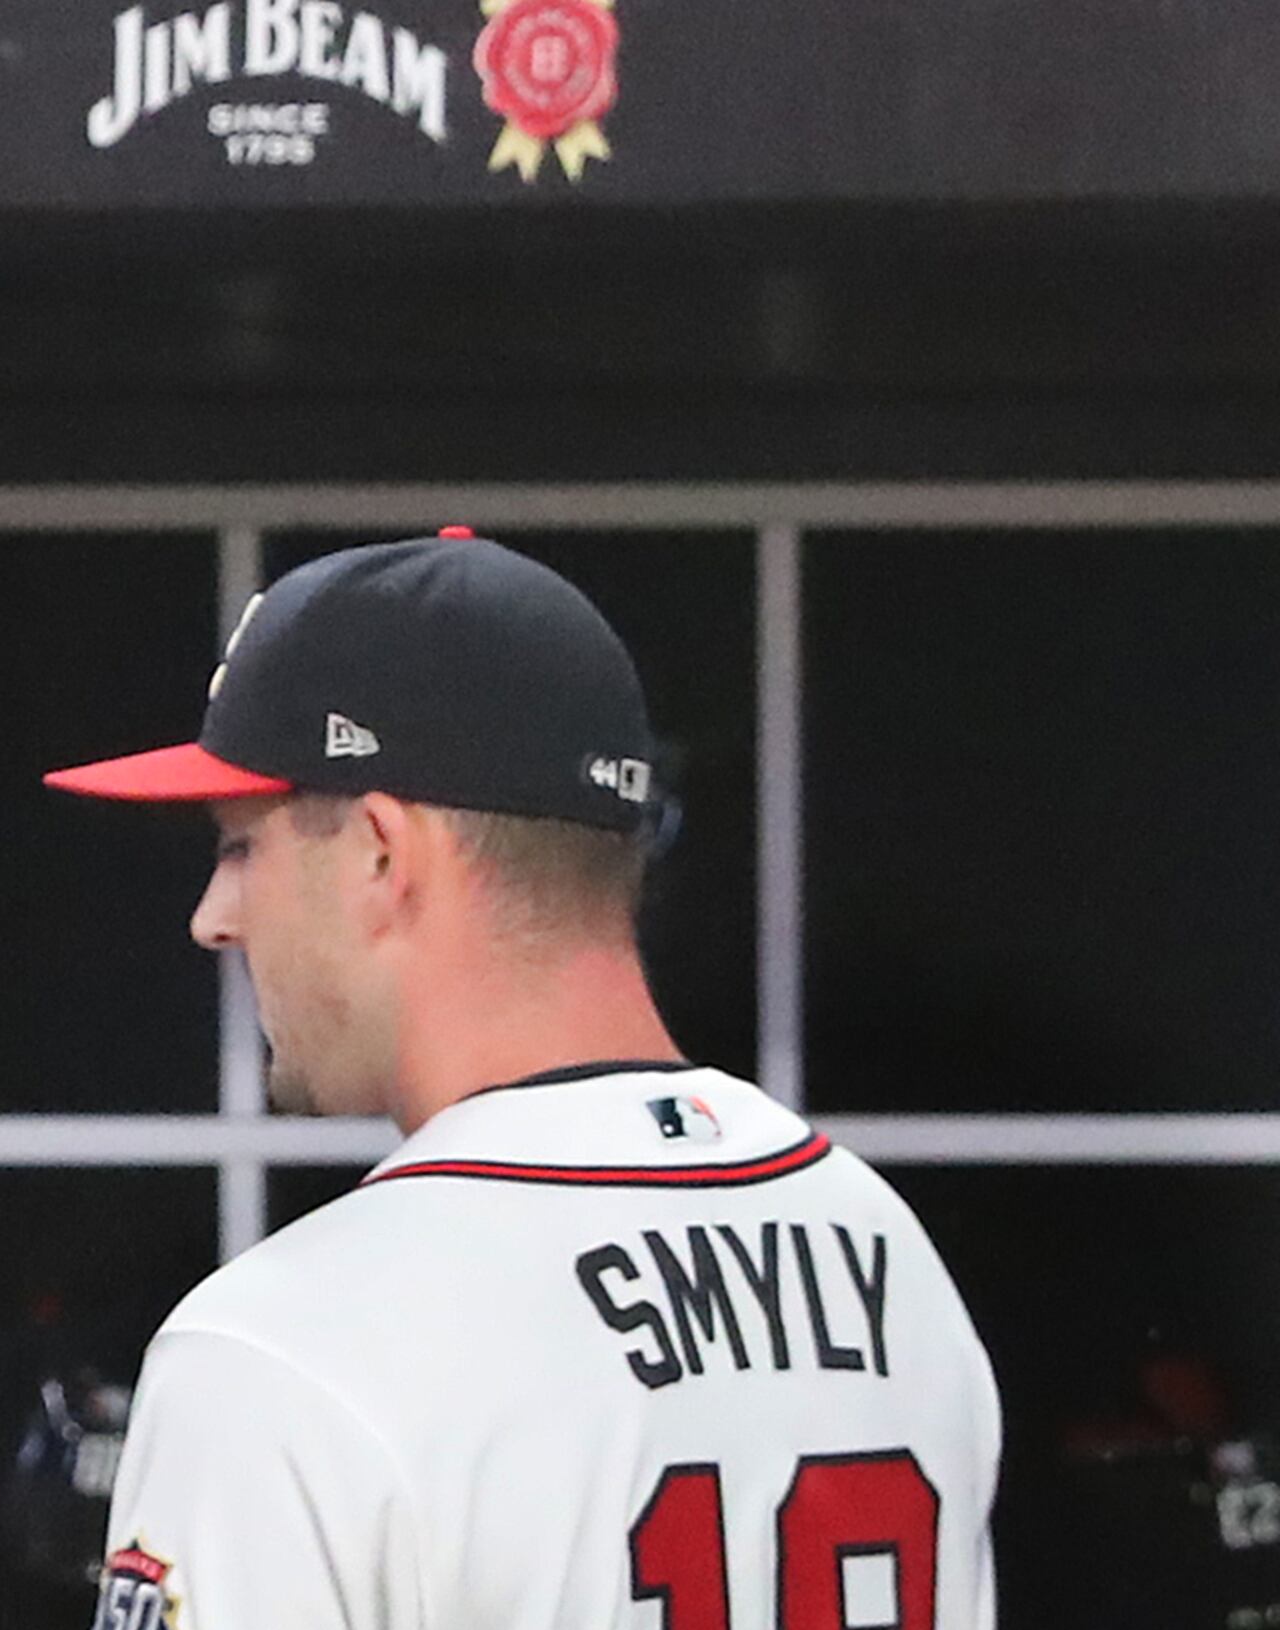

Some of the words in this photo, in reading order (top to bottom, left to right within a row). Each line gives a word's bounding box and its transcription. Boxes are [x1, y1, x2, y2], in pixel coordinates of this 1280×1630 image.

[87, 3, 231, 148] JIM
[244, 0, 447, 143] BEAM
[207, 103, 330, 136] SINCE
[575, 1221, 889, 1389] SMYLY
